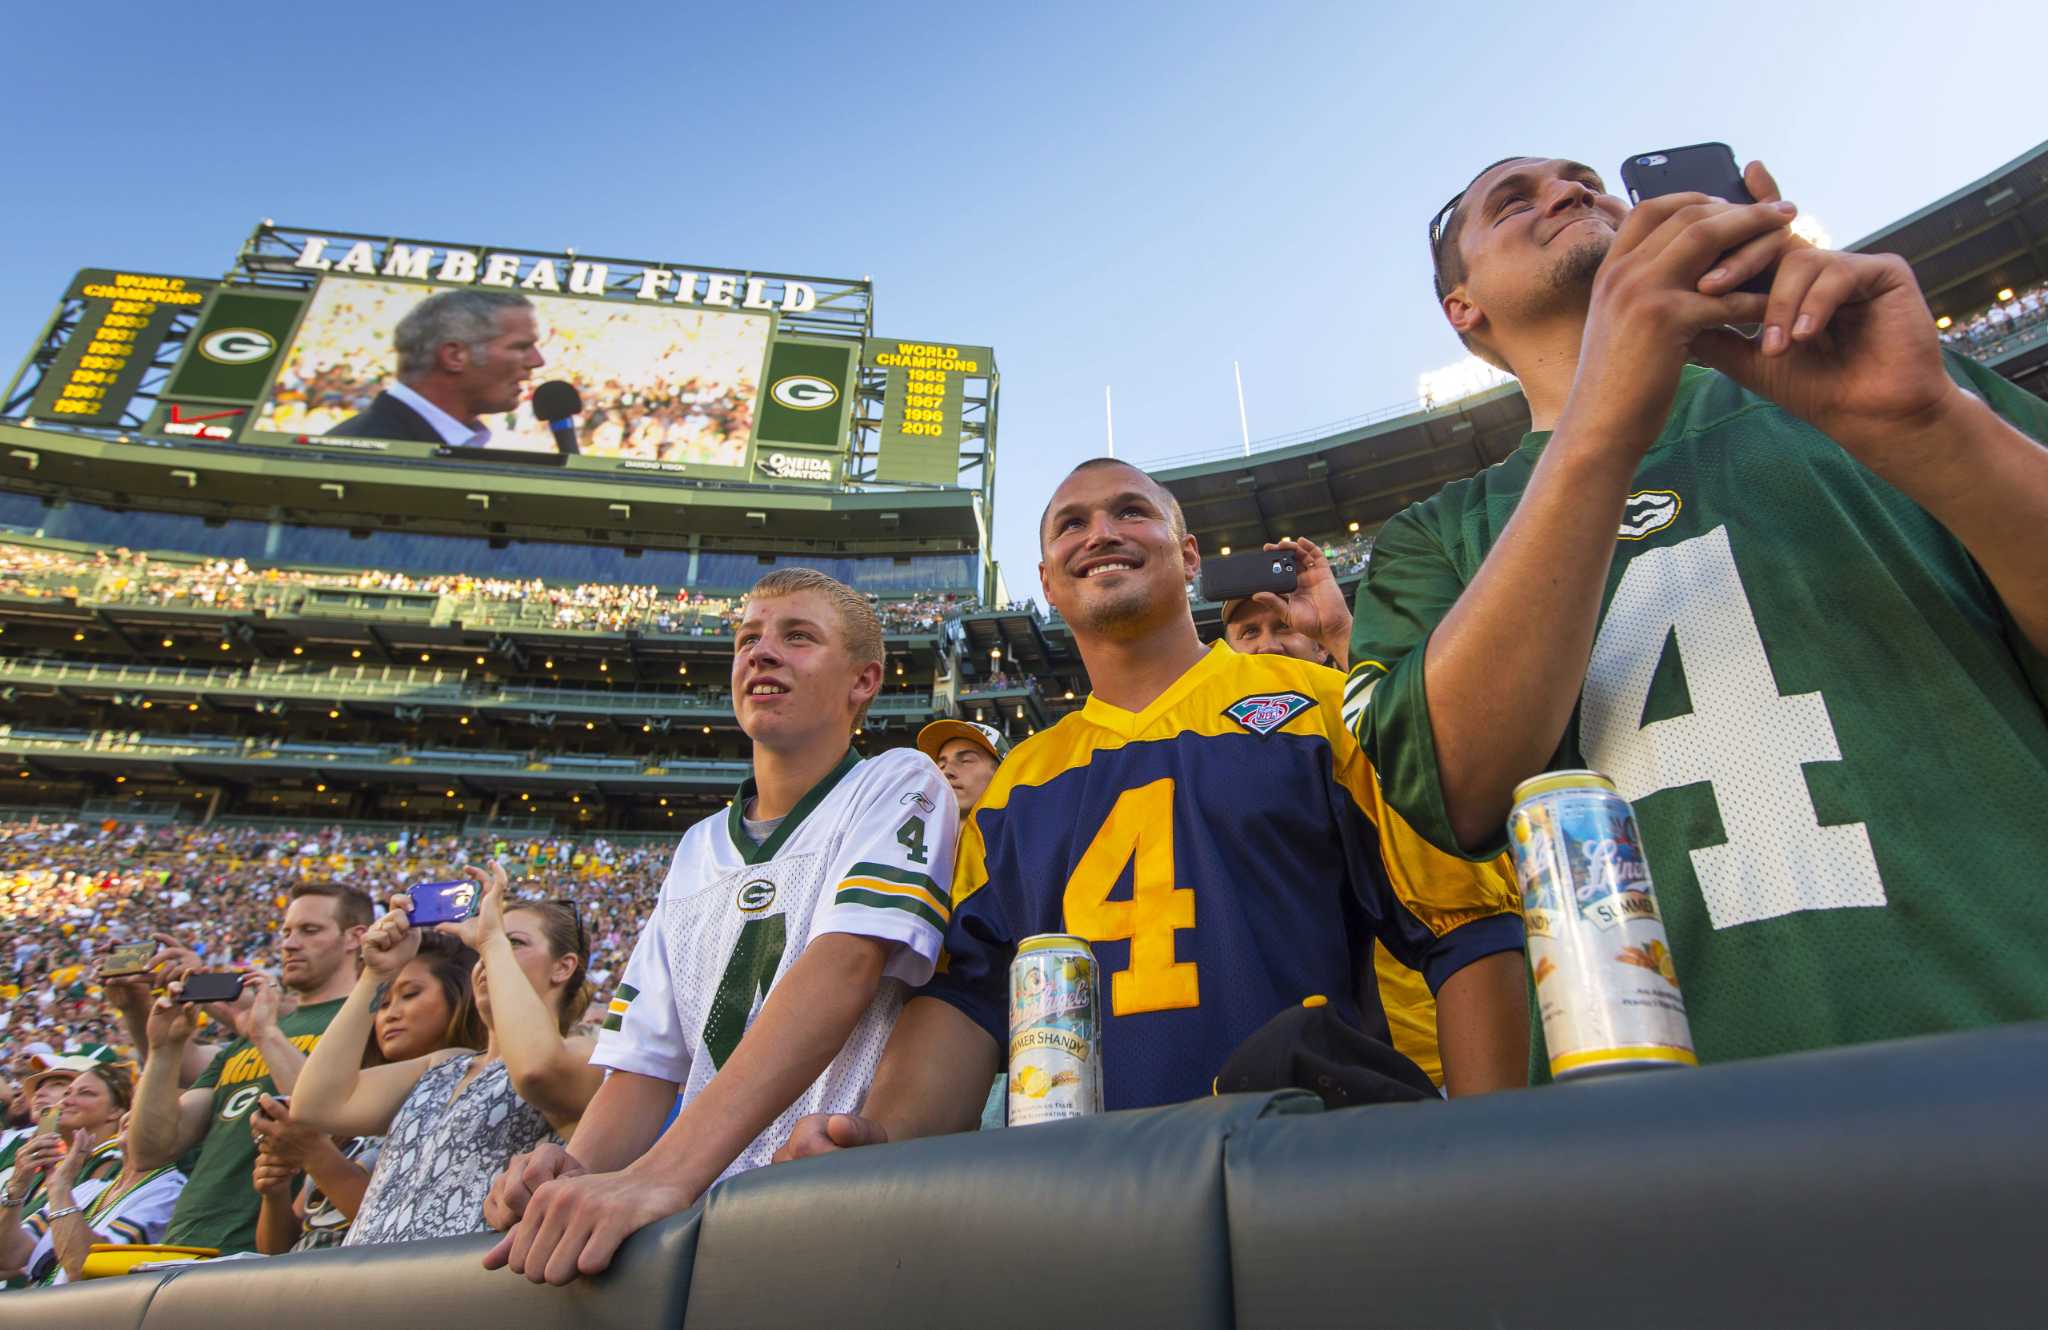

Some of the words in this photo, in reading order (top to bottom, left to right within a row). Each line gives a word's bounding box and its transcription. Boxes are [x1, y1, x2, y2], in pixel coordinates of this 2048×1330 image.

[115, 273, 186, 290] WORLD
[295, 237, 608, 296] LAMBEAU
[636, 268, 816, 312] FIELD
[82, 284, 202, 304] CHAMPIONS
[898, 343, 958, 359] WORLD
[876, 353, 977, 372] CHAMPIONS
[908, 369, 945, 382] 1965
[907, 382, 945, 396] 1966
[905, 395, 943, 409] 1967
[904, 408, 943, 422] 1996
[902, 422, 942, 436] 2010
[770, 453, 831, 471] ONEIDA
[783, 470, 831, 480] NATION
[1578, 524, 1887, 930] 4
[897, 815, 928, 864] 4
[1064, 778, 1200, 1016] 4
[1038, 1030, 1085, 1055] SHANDY
